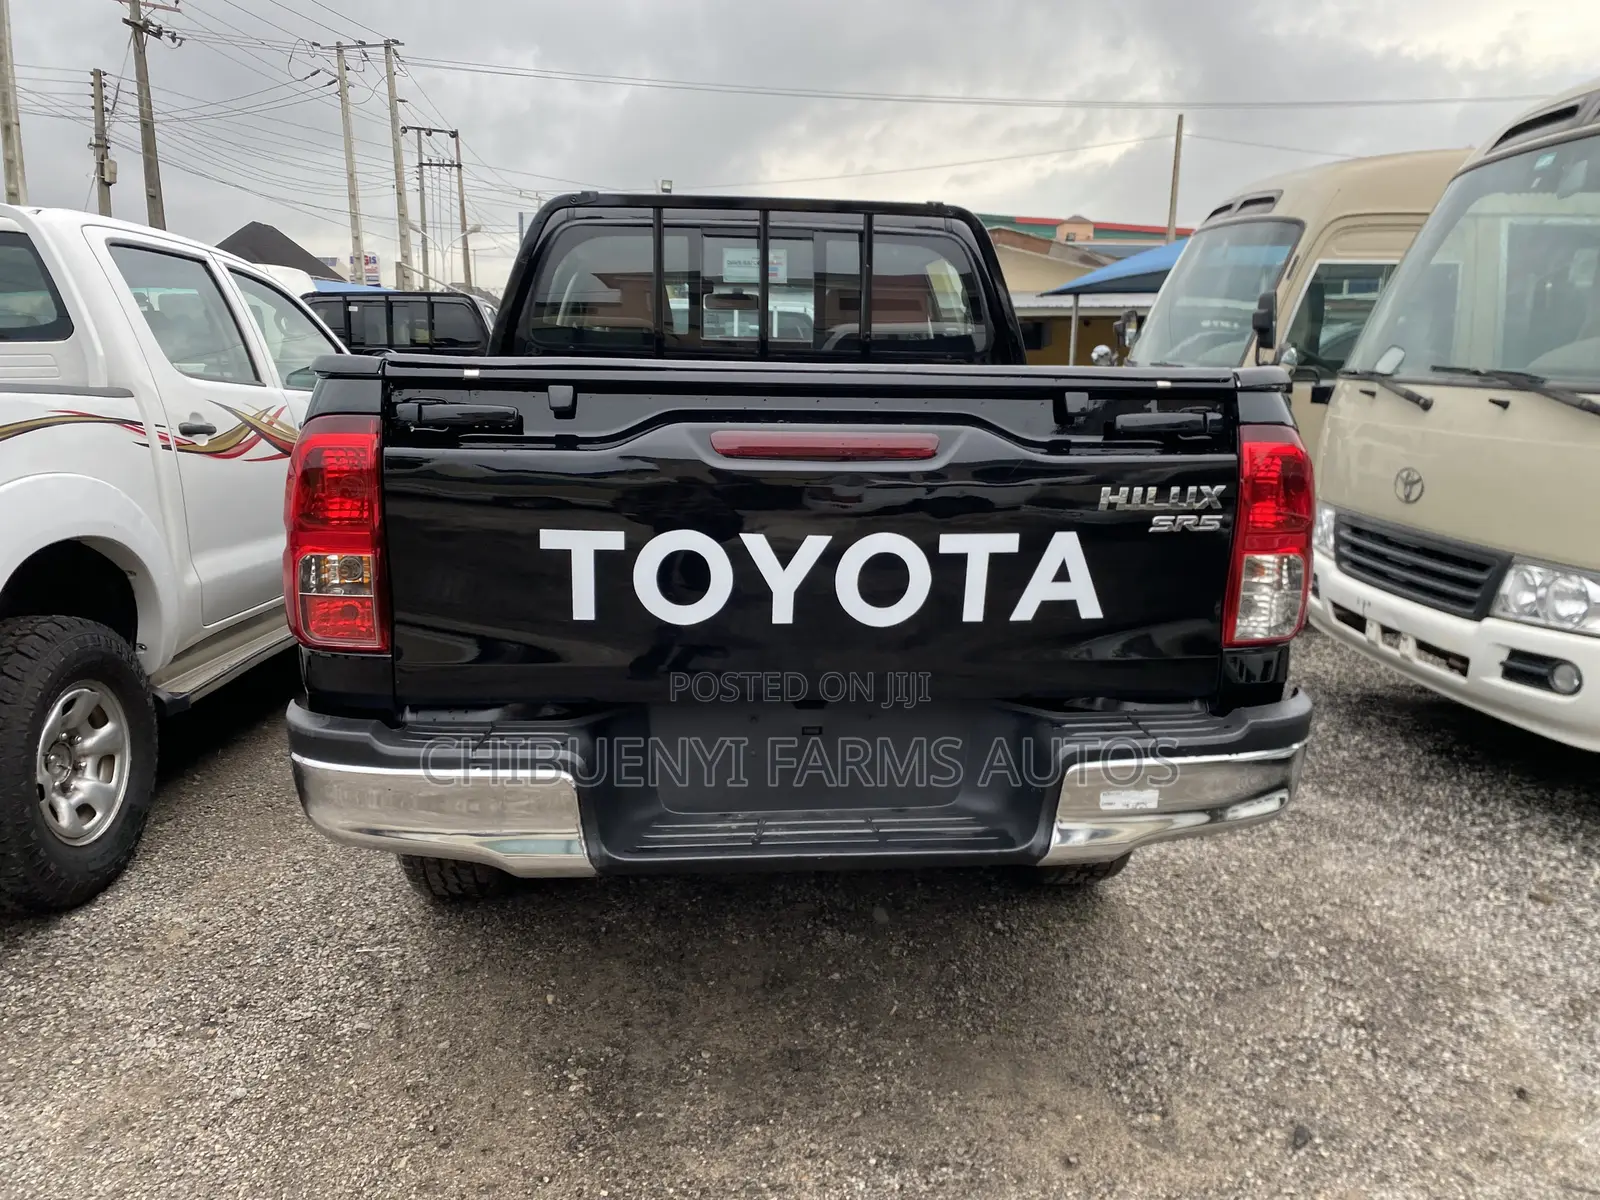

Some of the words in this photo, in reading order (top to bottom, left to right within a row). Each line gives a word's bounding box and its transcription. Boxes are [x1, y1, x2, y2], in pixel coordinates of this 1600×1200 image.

[1098, 484, 1227, 511] HILUX
[1148, 514, 1224, 533] SR5
[539, 528, 1104, 628] TOYOTA
